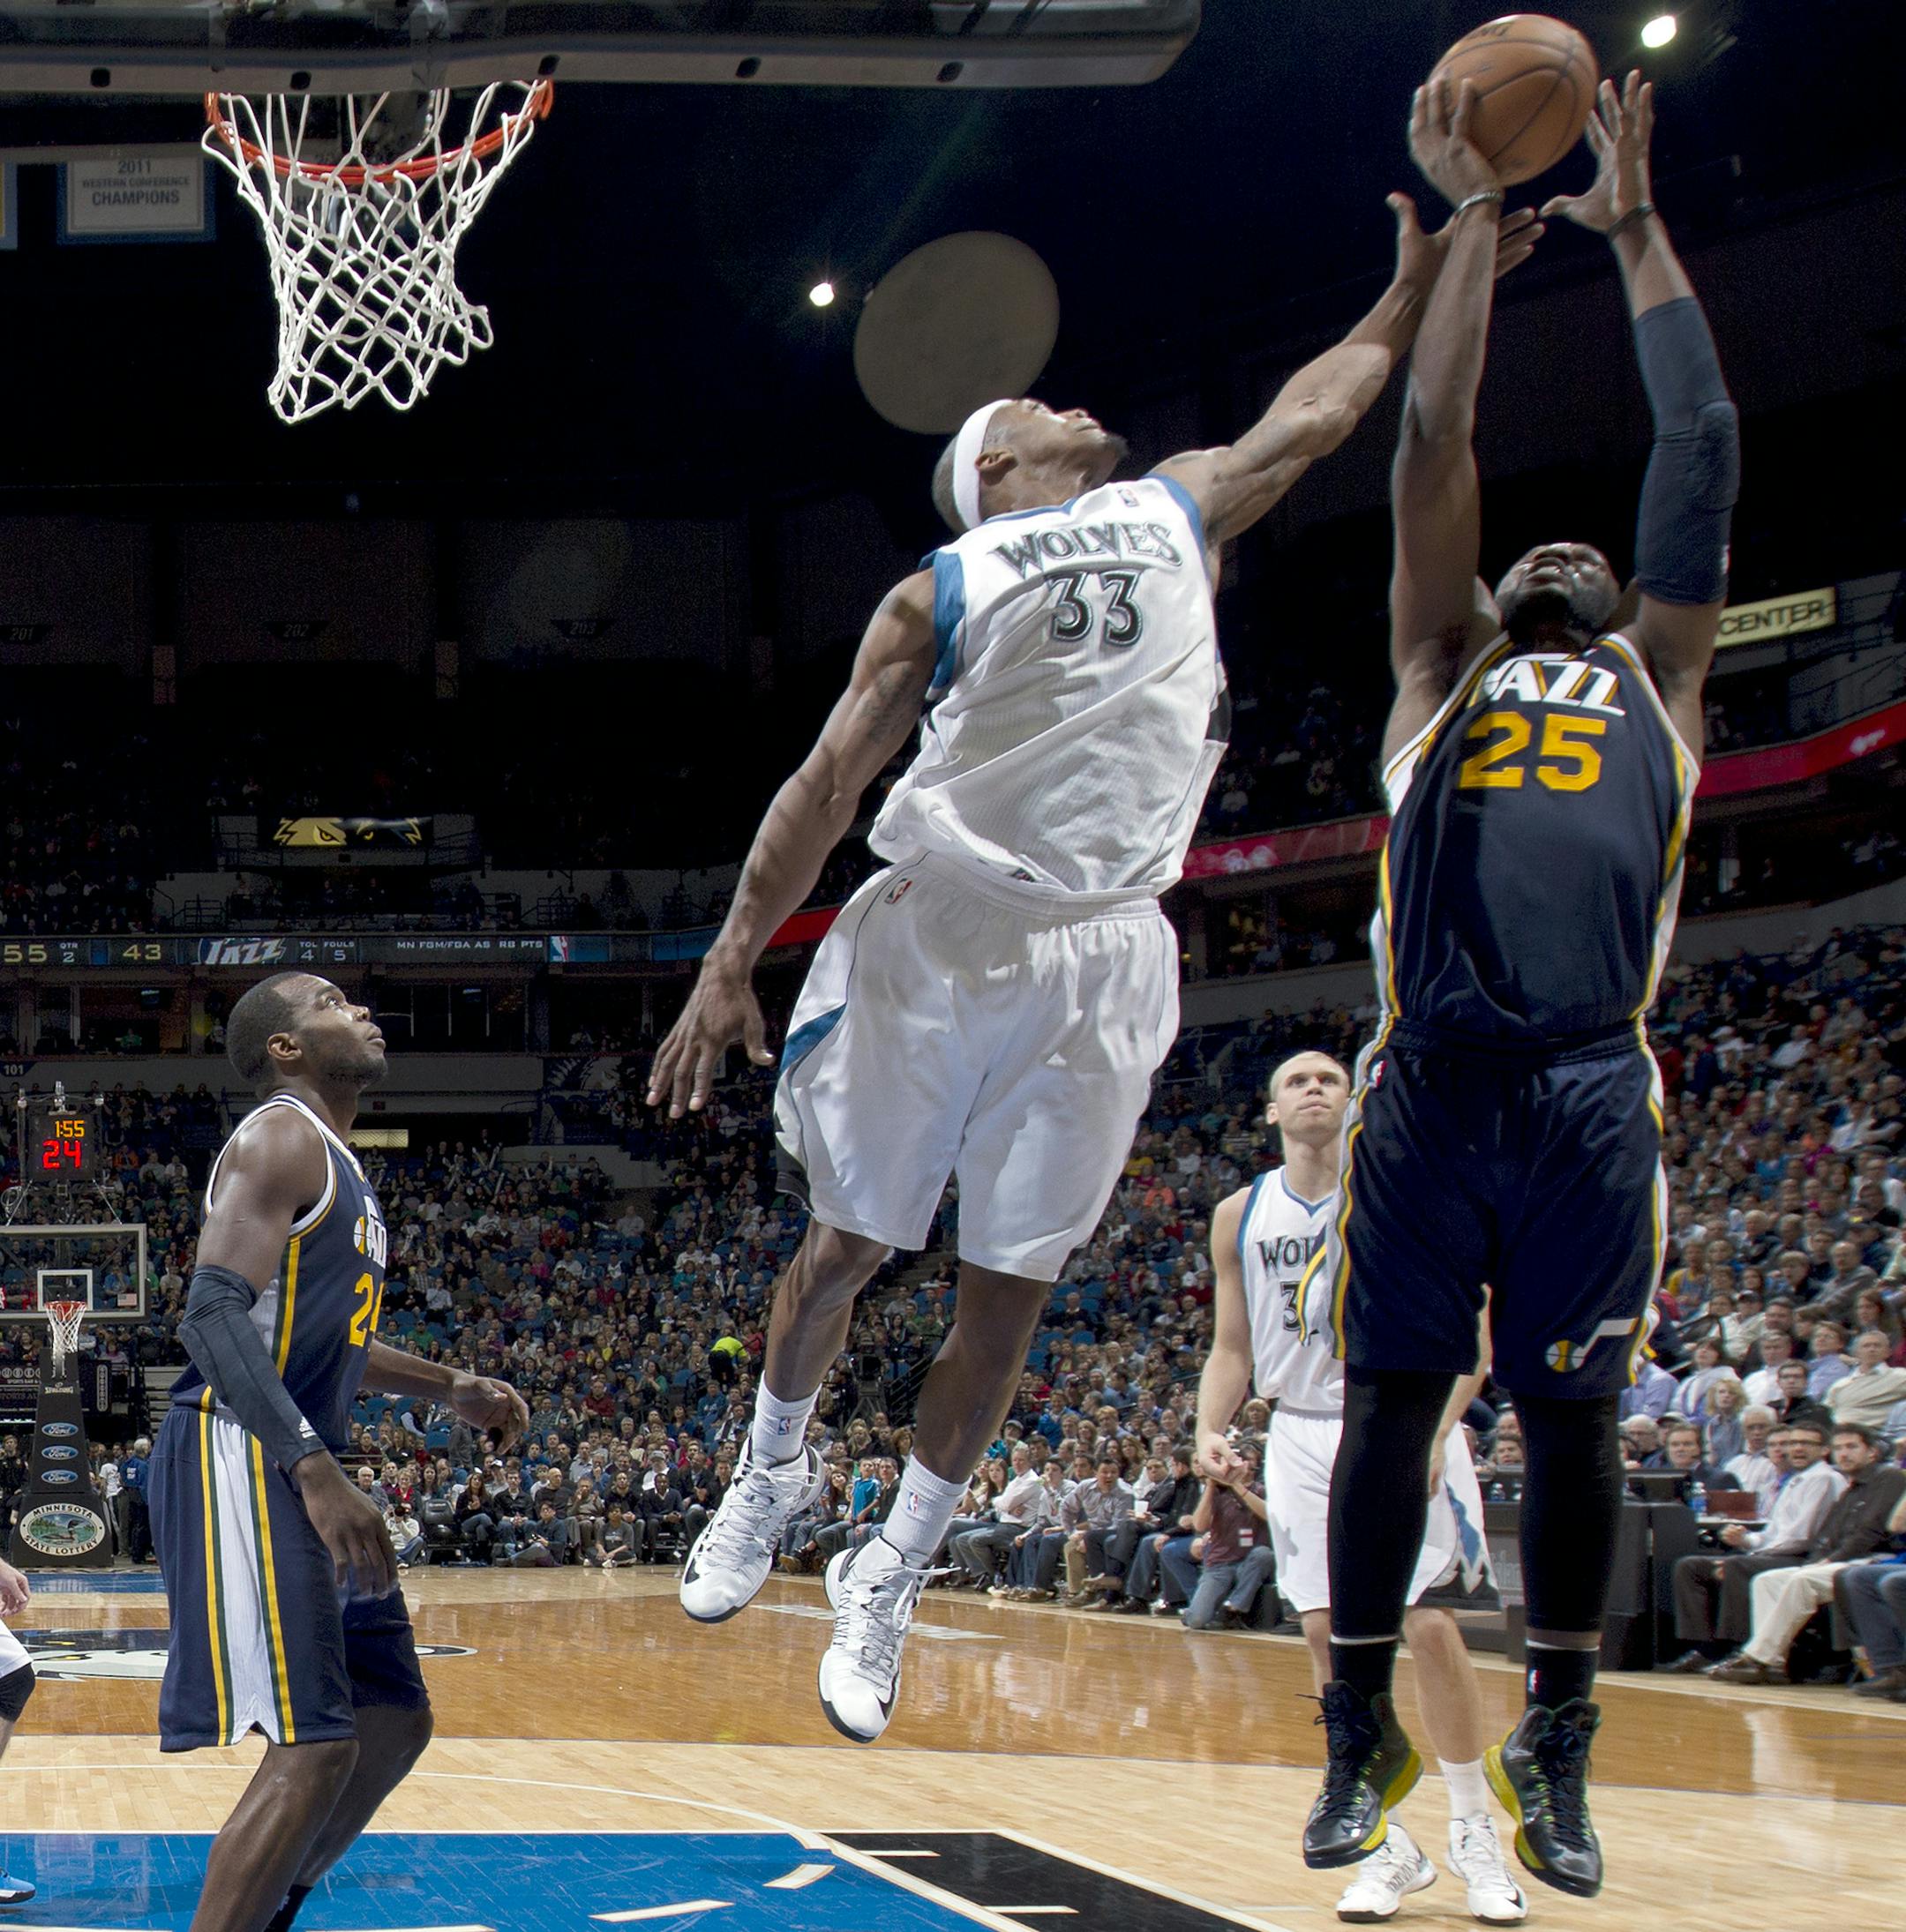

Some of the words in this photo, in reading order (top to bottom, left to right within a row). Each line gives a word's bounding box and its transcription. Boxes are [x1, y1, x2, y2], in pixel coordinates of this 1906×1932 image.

[118, 160, 152, 174] 2011
[83, 177, 127, 188] WESTERN
[129, 176, 190, 187] CONFERENCE
[92, 190, 180, 206] CHAMPIONS
[987, 521, 1183, 580] WOLVES
[1044, 568, 1144, 648] 33
[1721, 598, 1825, 635] CENTER
[1459, 711, 1607, 793] 25
[205, 938, 282, 964] JAZZ
[397, 940, 416, 949] MN
[418, 940, 471, 949] FGM/FGA
[475, 940, 491, 949] AS
[521, 940, 544, 949] PTS
[4, 945, 47, 963] 55
[63, 952, 75, 962] 2
[123, 944, 162, 961] 43
[300, 950, 314, 961] 4
[334, 950, 347, 961] 5
[4, 1065, 24, 1075] 101
[55, 1120, 86, 1138] 1:55
[42, 1139, 82, 1170] 24
[47, 1424, 71, 1435] Ford
[47, 1447, 71, 1459] Ford
[47, 1471, 71, 1482] Ford
[33, 1504, 93, 1519] MINNESOTA
[25, 1535, 50, 1553] STATE
[56, 1539, 98, 1554] LOTTERY
